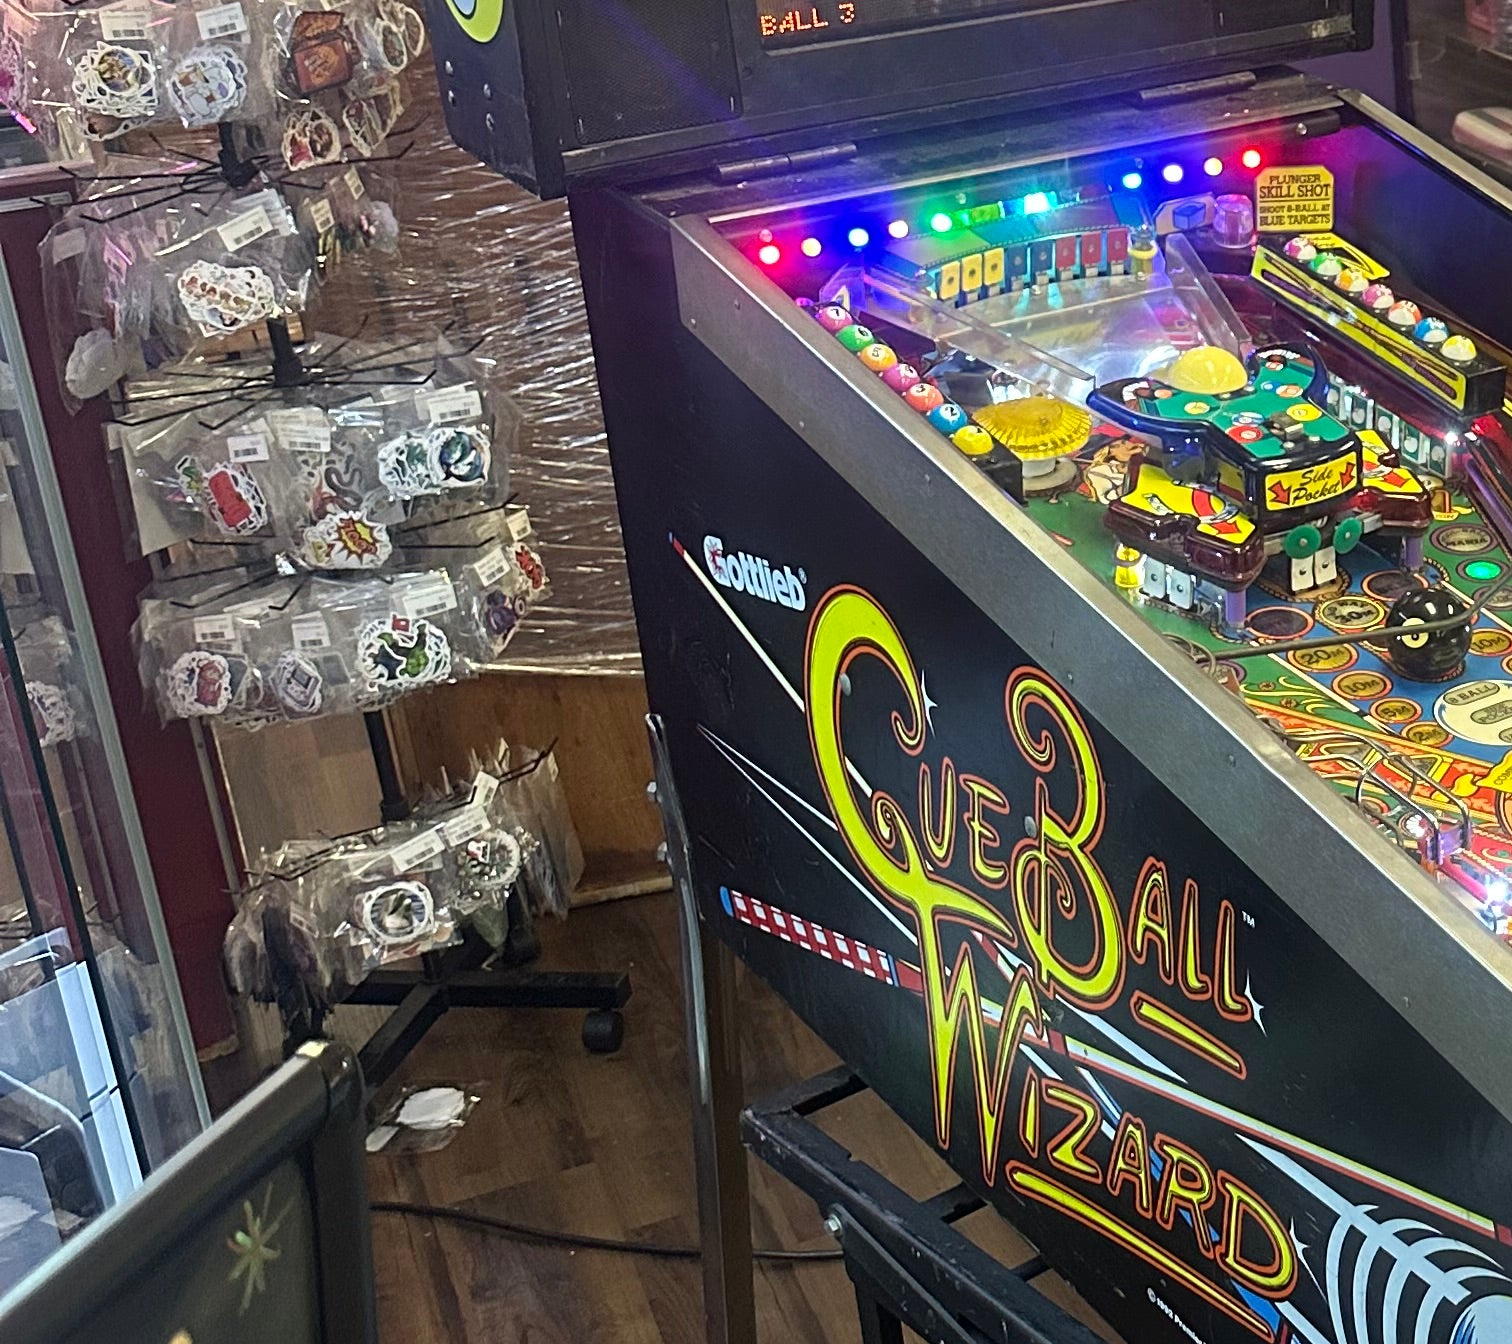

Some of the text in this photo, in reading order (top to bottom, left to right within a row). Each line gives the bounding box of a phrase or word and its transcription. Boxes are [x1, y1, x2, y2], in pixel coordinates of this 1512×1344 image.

[759, 3, 856, 36] BALL 3
[1269, 174, 1321, 185] PLUNGER
[1260, 184, 1330, 198] SKILL SHOT
[1260, 205, 1285, 213] SHOOT
[1260, 214, 1330, 226] BLUE TARGETS
[1301, 468, 1333, 487] Side
[1291, 481, 1341, 506] Pocket
[703, 534, 803, 611] Gottlieb
[1459, 684, 1498, 701] BALL
[801, 583, 1011, 914] CUE
[1004, 663, 1255, 1023] BALL
[915, 918, 1298, 1300] WIZARD
